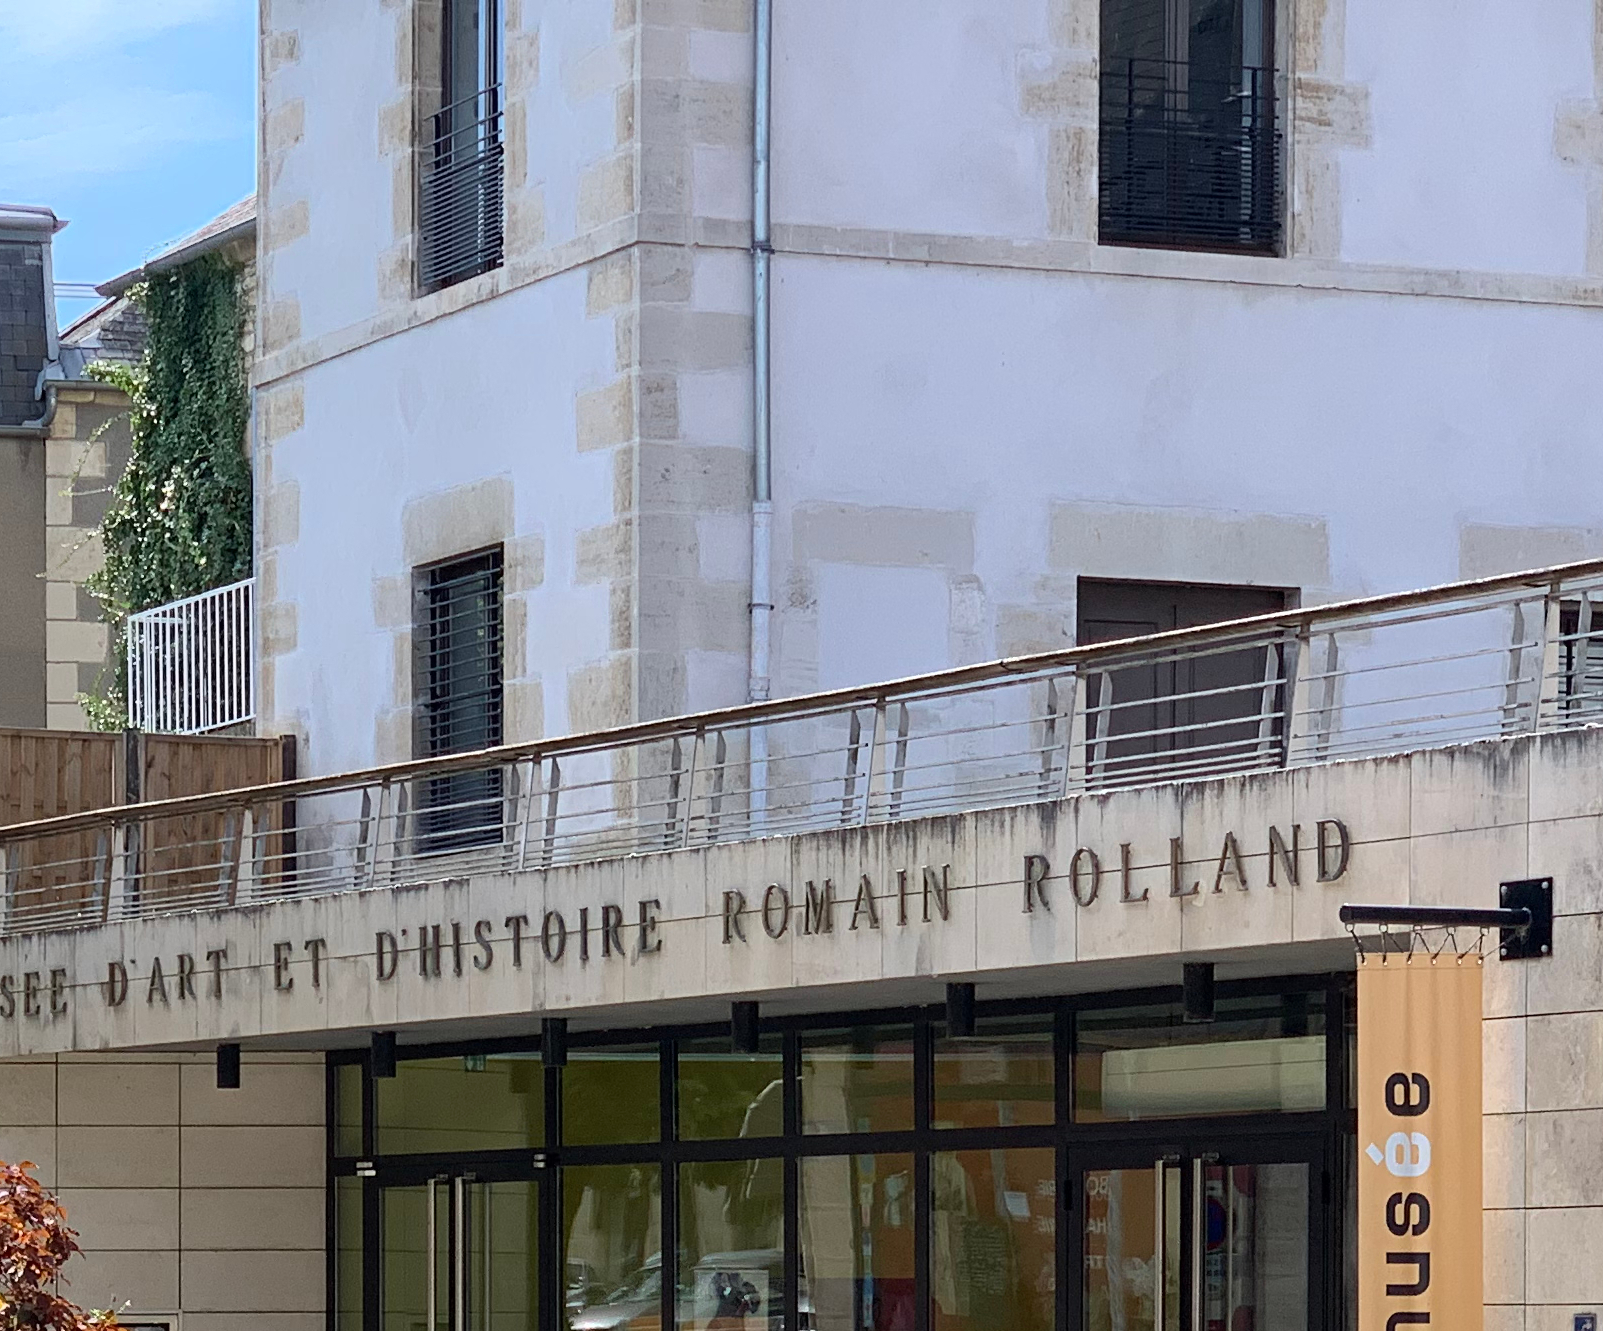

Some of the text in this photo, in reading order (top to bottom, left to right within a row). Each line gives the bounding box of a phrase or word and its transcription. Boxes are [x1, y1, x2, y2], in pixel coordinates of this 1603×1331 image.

[107, 948, 229, 1007] D'ART
[272, 938, 327, 990] ET
[375, 898, 663, 982] D'HISTOIRE
[721, 862, 950, 944] ROMAIN
[1022, 818, 1352, 914] ROLLAND
